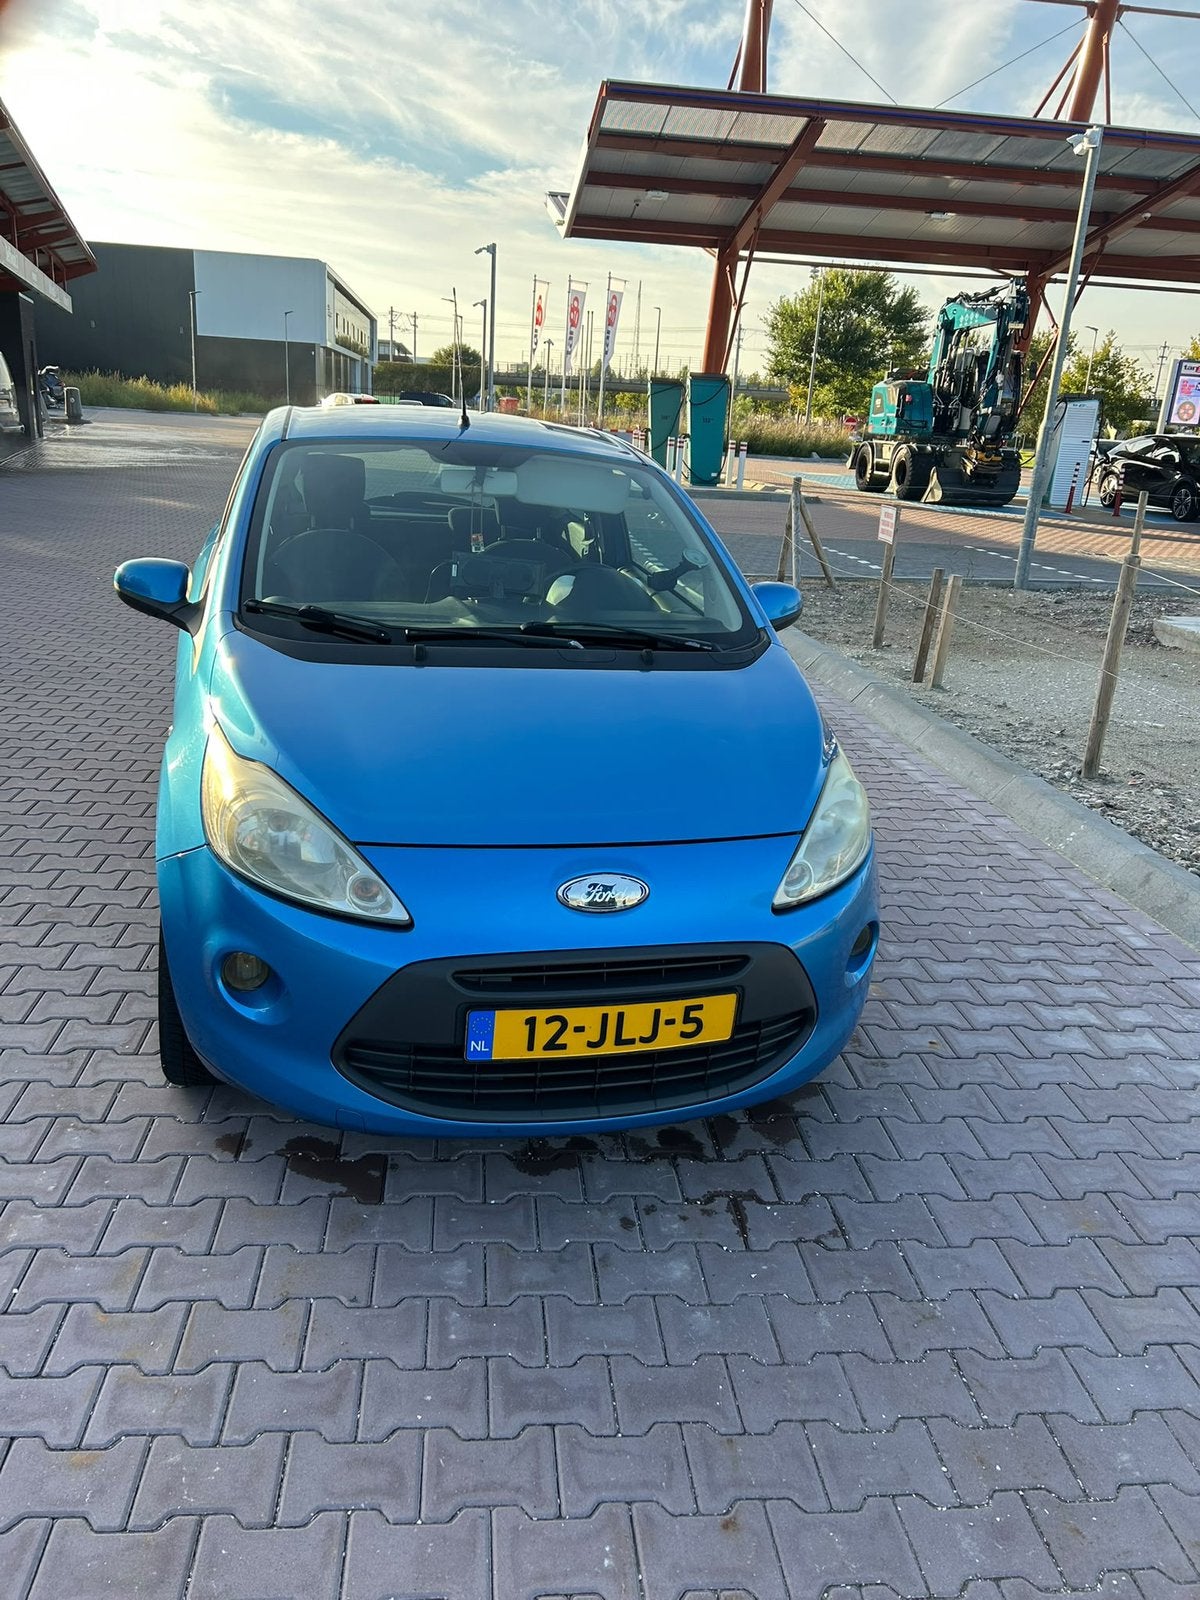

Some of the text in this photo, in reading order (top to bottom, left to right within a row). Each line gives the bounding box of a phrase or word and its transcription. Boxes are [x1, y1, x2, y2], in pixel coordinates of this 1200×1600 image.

[580, 882, 629, 903] Ford
[524, 1004, 704, 1052] 12-JLJ-5
[470, 1040, 489, 1052] NL
